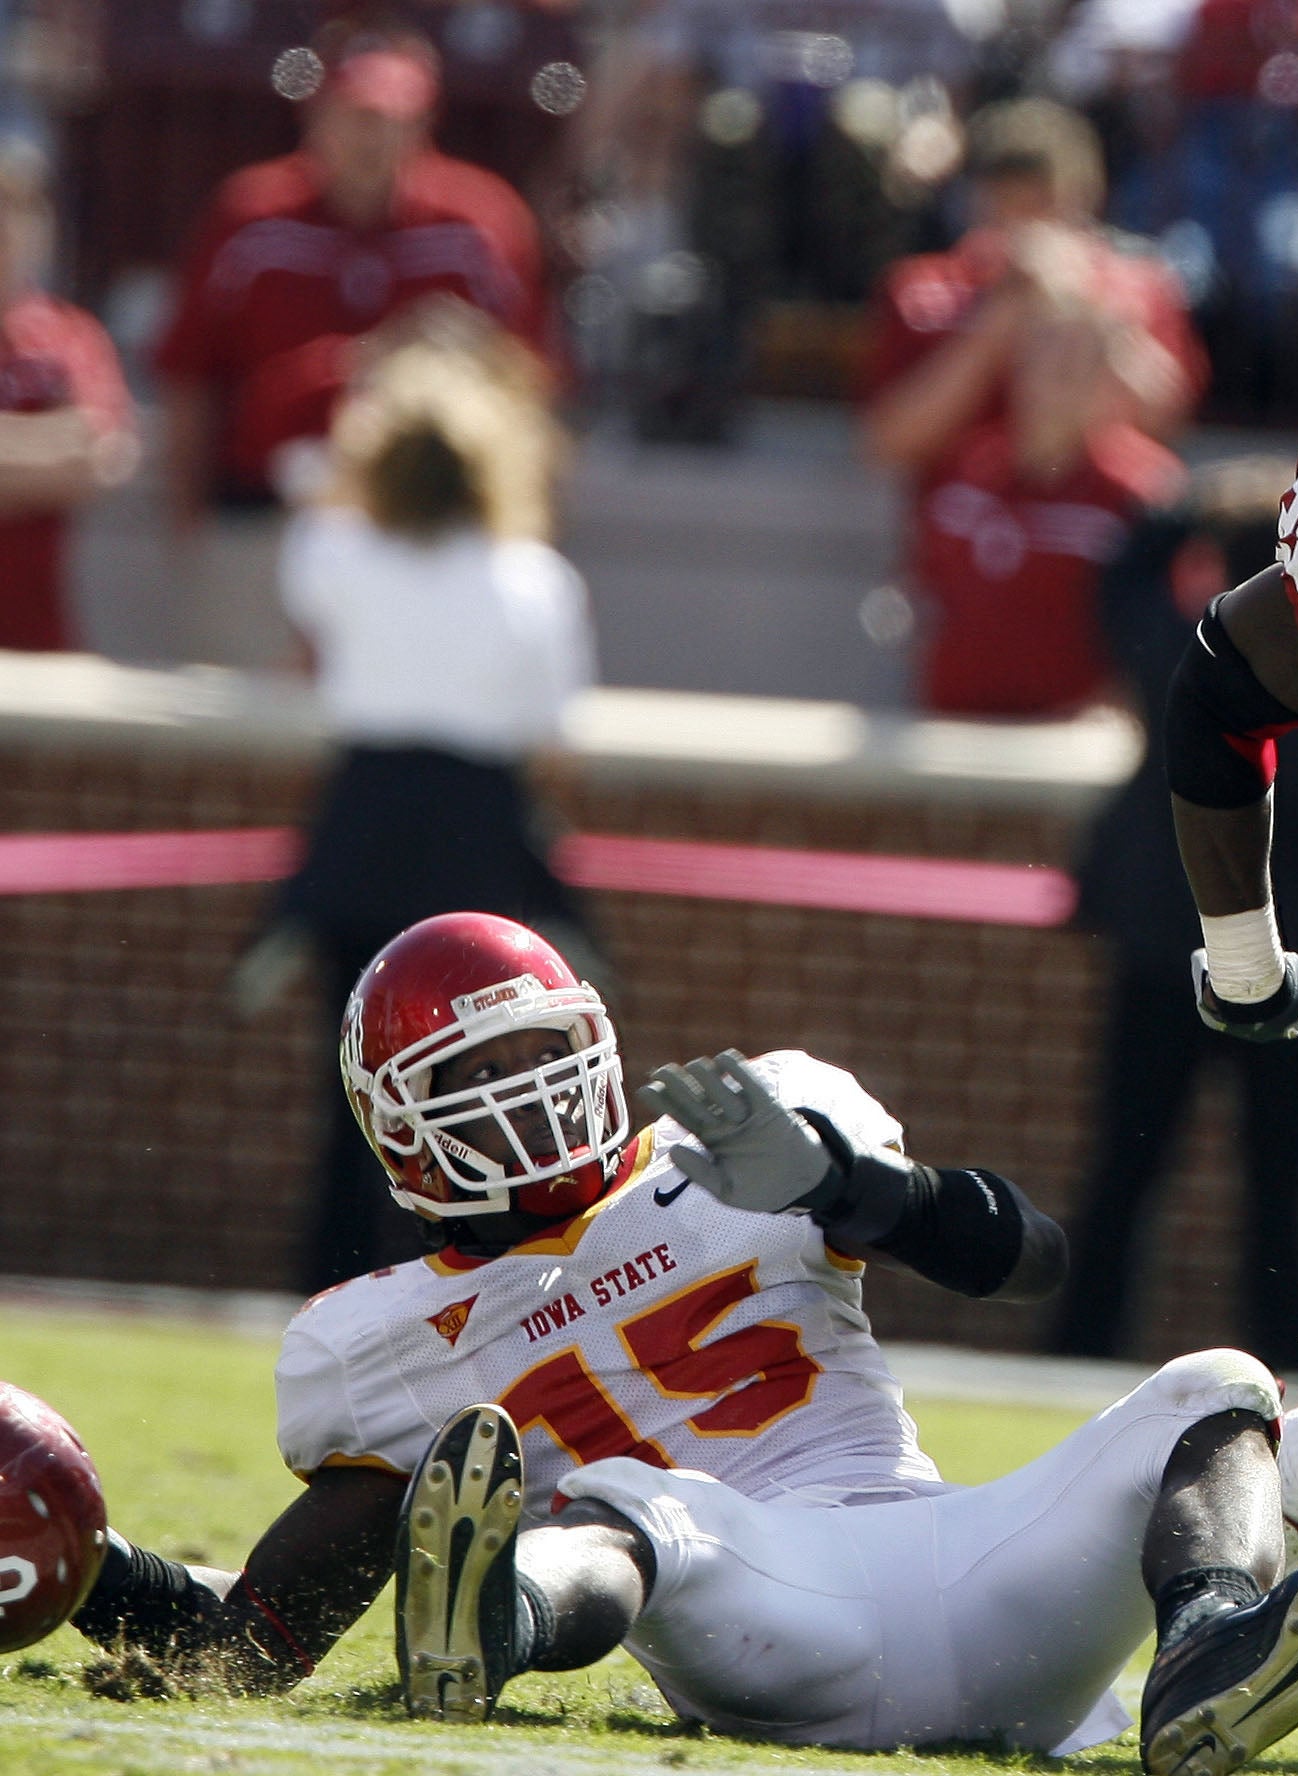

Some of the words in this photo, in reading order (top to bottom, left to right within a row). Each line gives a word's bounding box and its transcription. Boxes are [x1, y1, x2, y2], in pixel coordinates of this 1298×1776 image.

[432, 1131, 468, 1159] ddell
[520, 1293, 586, 1342] IOWA
[590, 1243, 677, 1307] STATE
[496, 1257, 825, 1470] 15
